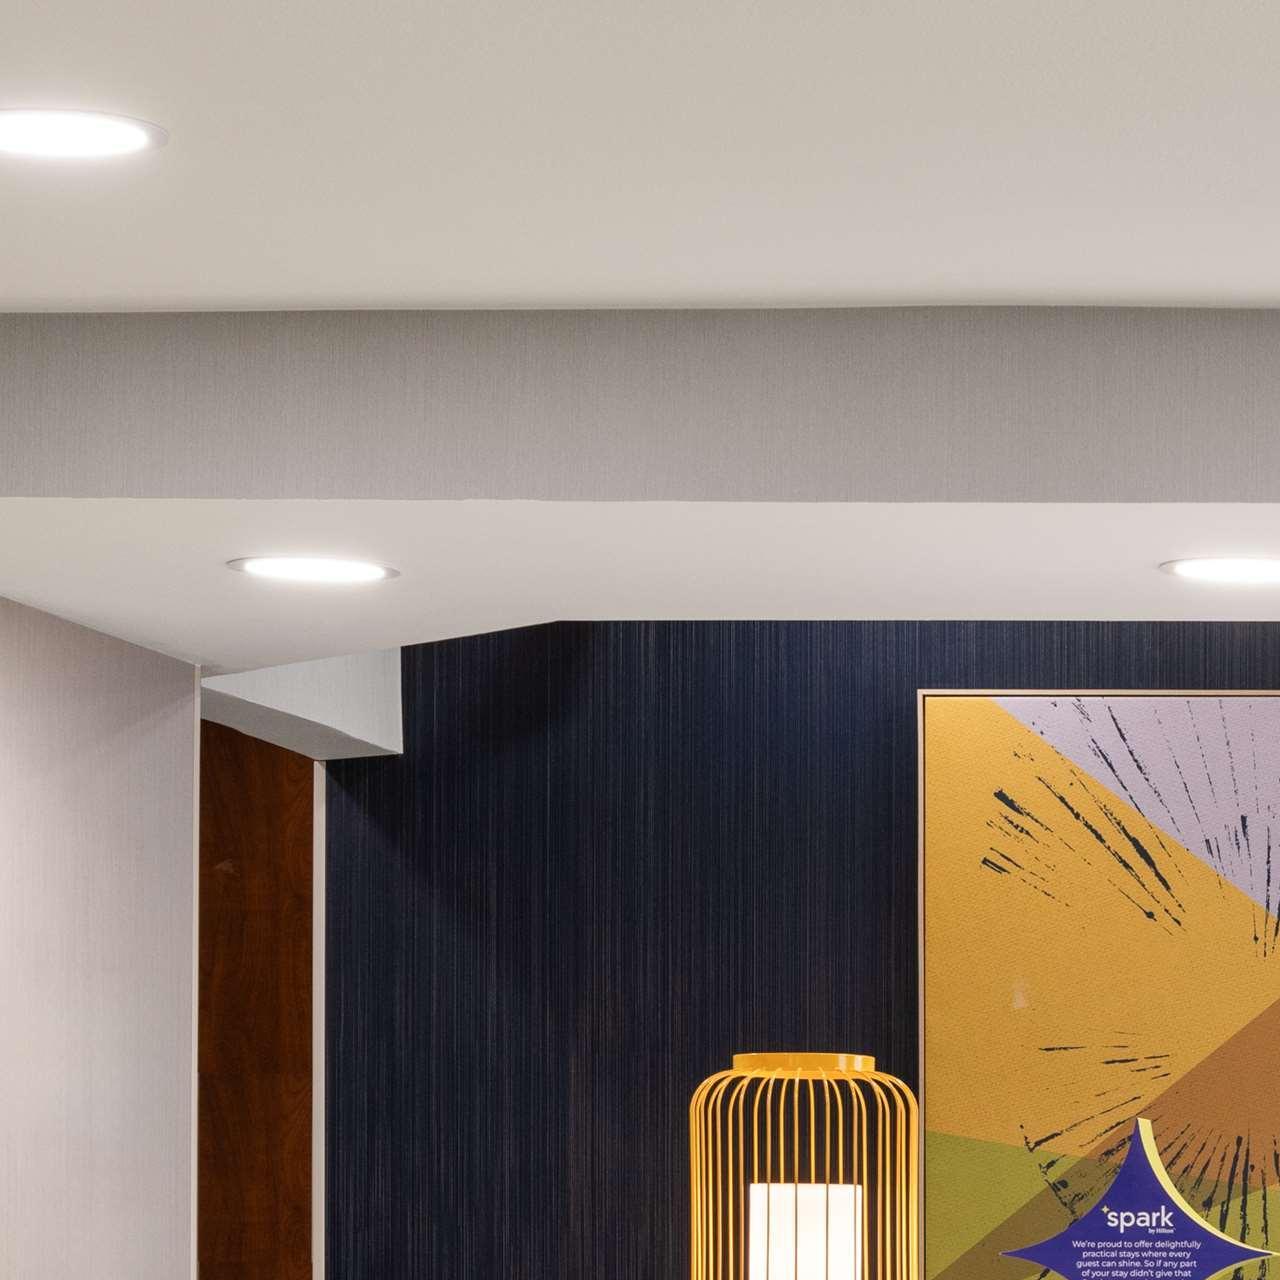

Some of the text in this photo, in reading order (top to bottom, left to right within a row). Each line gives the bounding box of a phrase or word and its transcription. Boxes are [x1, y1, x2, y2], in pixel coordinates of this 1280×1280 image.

[1106, 1205, 1174, 1234] spark
[1072, 1240, 1096, 1248] We're
[1097, 1240, 1122, 1250] proud
[1134, 1240, 1153, 1248] offer
[1154, 1240, 1202, 1250] delightfully
[1082, 1251, 1117, 1259] practical
[1119, 1251, 1140, 1259] stays
[1076, 1261, 1100, 1269] guest
[1118, 1260, 1142, 1268] shine.
[1143, 1260, 1155, 1268] So
[1156, 1260, 1162, 1268] if
[1162, 1261, 1178, 1269] any
[1179, 1261, 1197, 1269] part
[1081, 1270, 1090, 1278] of
[1091, 1271, 1110, 1279] your
[1111, 1270, 1128, 1279] stay
[1155, 1270, 1173, 1279] give
[1174, 1270, 1192, 1278] that
